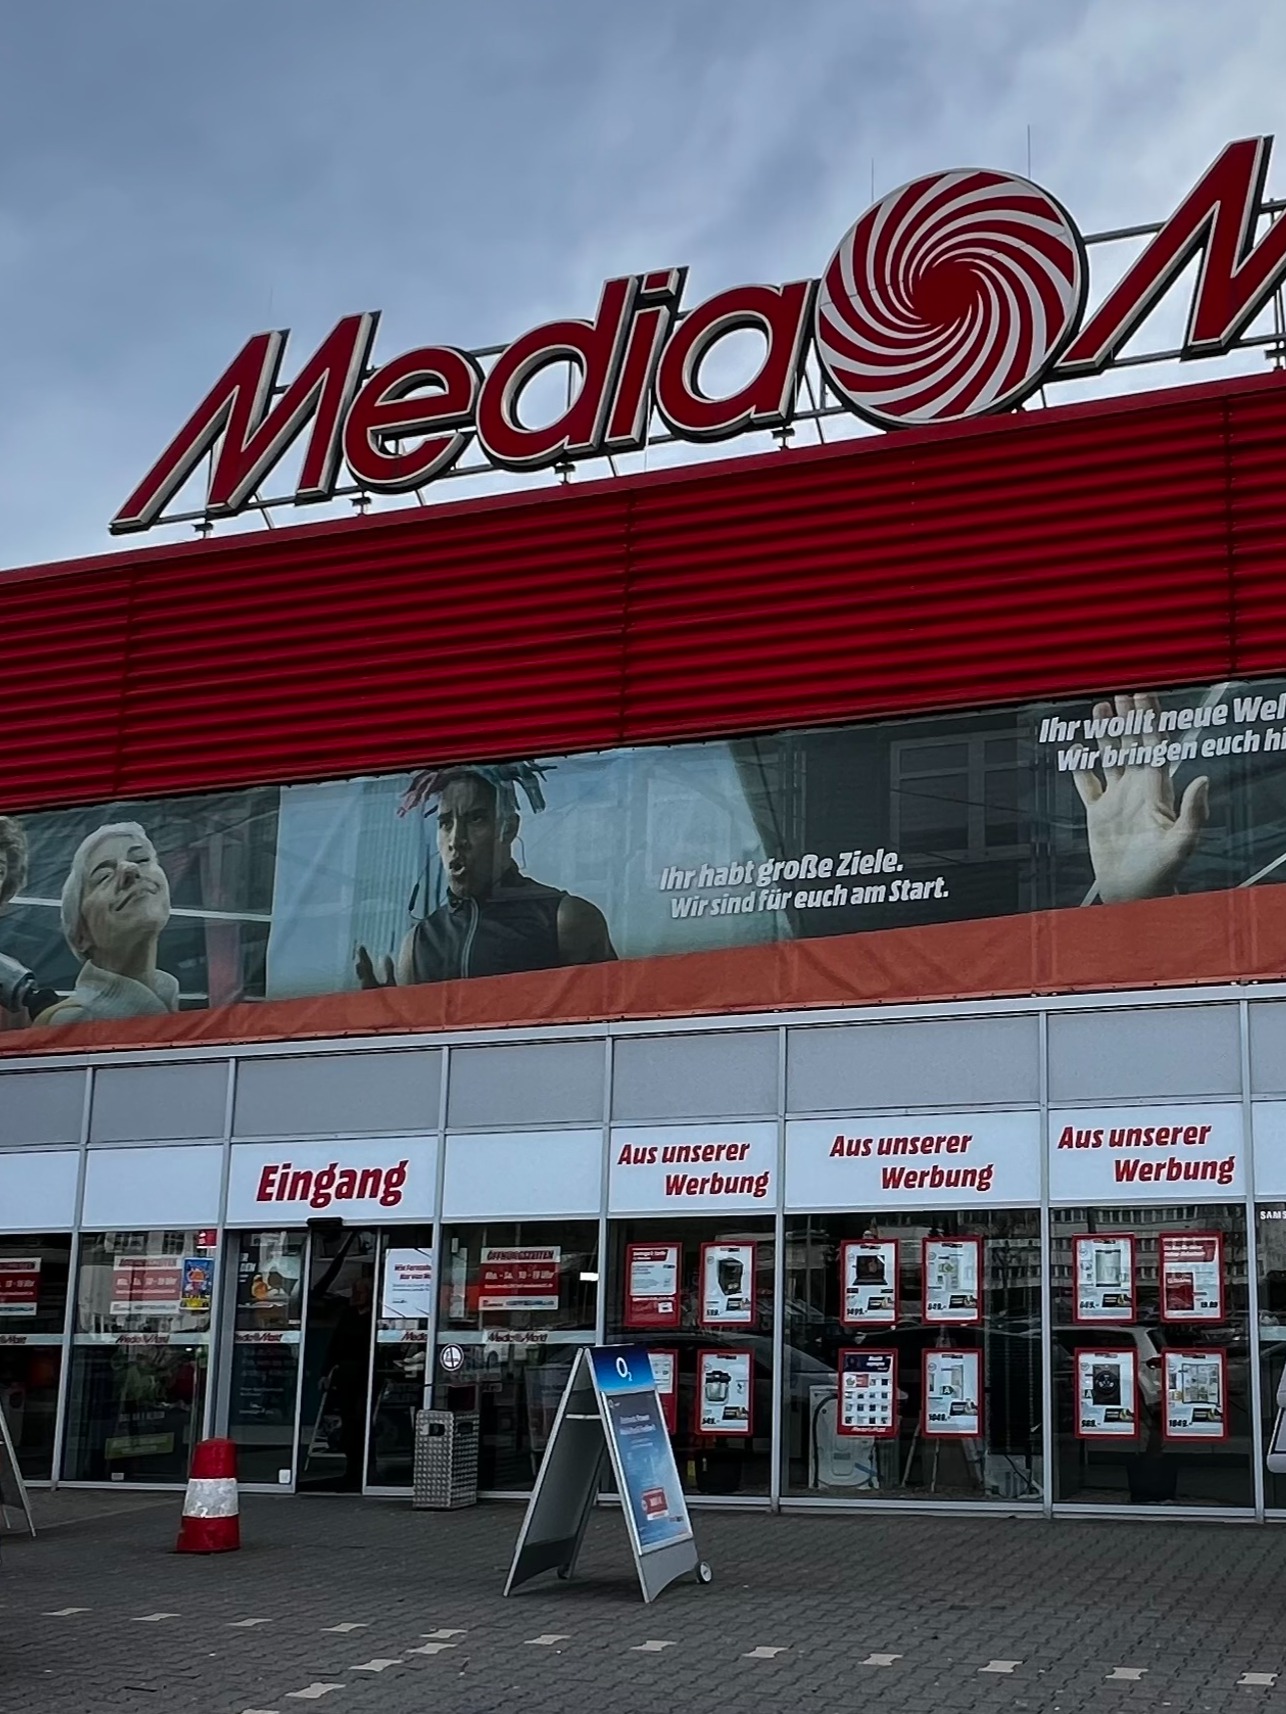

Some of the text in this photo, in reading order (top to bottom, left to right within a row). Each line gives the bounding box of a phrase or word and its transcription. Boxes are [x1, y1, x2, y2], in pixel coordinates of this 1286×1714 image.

[1038, 716, 1082, 743] Ihr
[1083, 709, 1156, 740] wollt
[1158, 703, 1229, 732] neue
[1057, 747, 1099, 772] Wir
[1102, 738, 1198, 768] bringen
[1201, 730, 1259, 758] euch
[659, 848, 904, 892] Ihr habt große Ziele.
[671, 876, 949, 919] Wir sind für euch am Start.
[829, 1133, 974, 1157] Aus unserer
[1057, 1124, 1212, 1150] Aus unserer
[617, 1141, 750, 1165] Aus unserer
[255, 1158, 410, 1209] Eingang
[664, 1169, 770, 1198] Werbung
[881, 1163, 994, 1192] Werbung
[1114, 1155, 1236, 1186] Werbung
